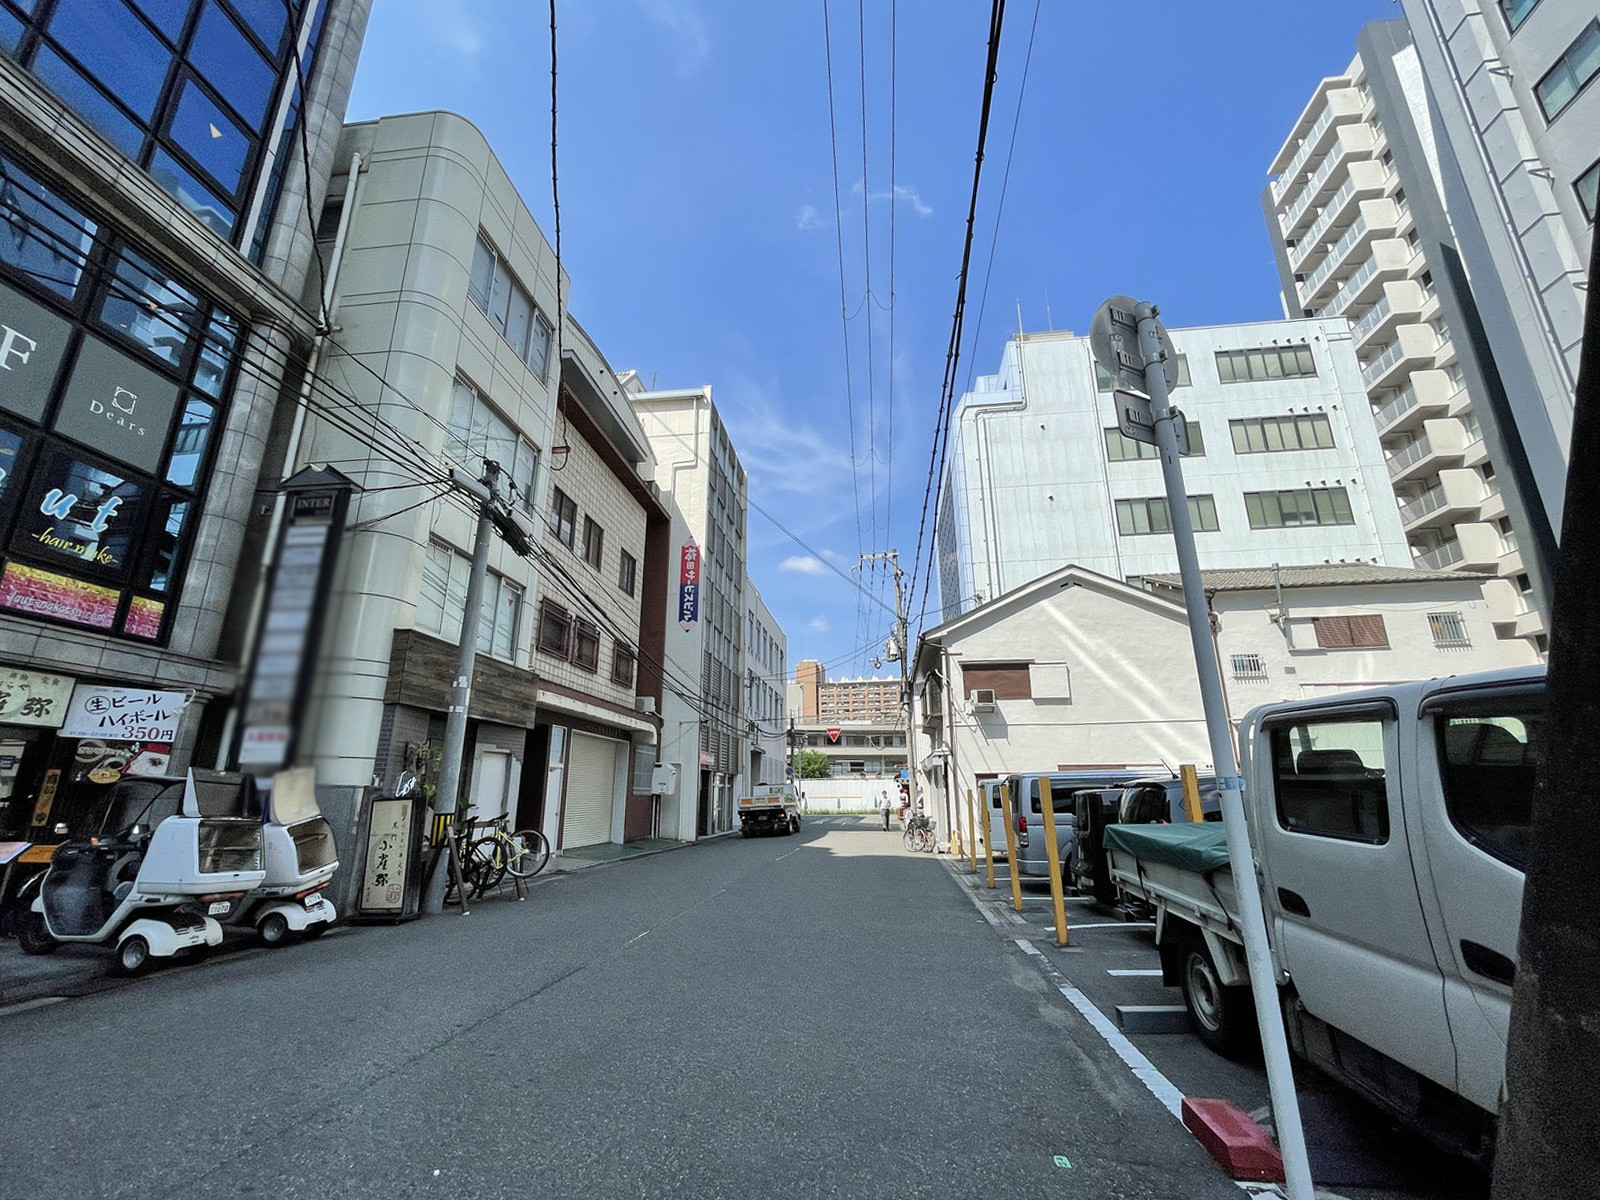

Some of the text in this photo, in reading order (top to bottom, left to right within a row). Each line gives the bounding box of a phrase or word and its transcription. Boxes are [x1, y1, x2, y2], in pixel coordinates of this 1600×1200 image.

[89, 399, 146, 436] Dears
[297, 497, 330, 509] INTER
[683, 547, 698, 622] 梅田サービスビル
[98, 709, 172, 728] ハイボール
[121, 725, 174, 741] 350円
